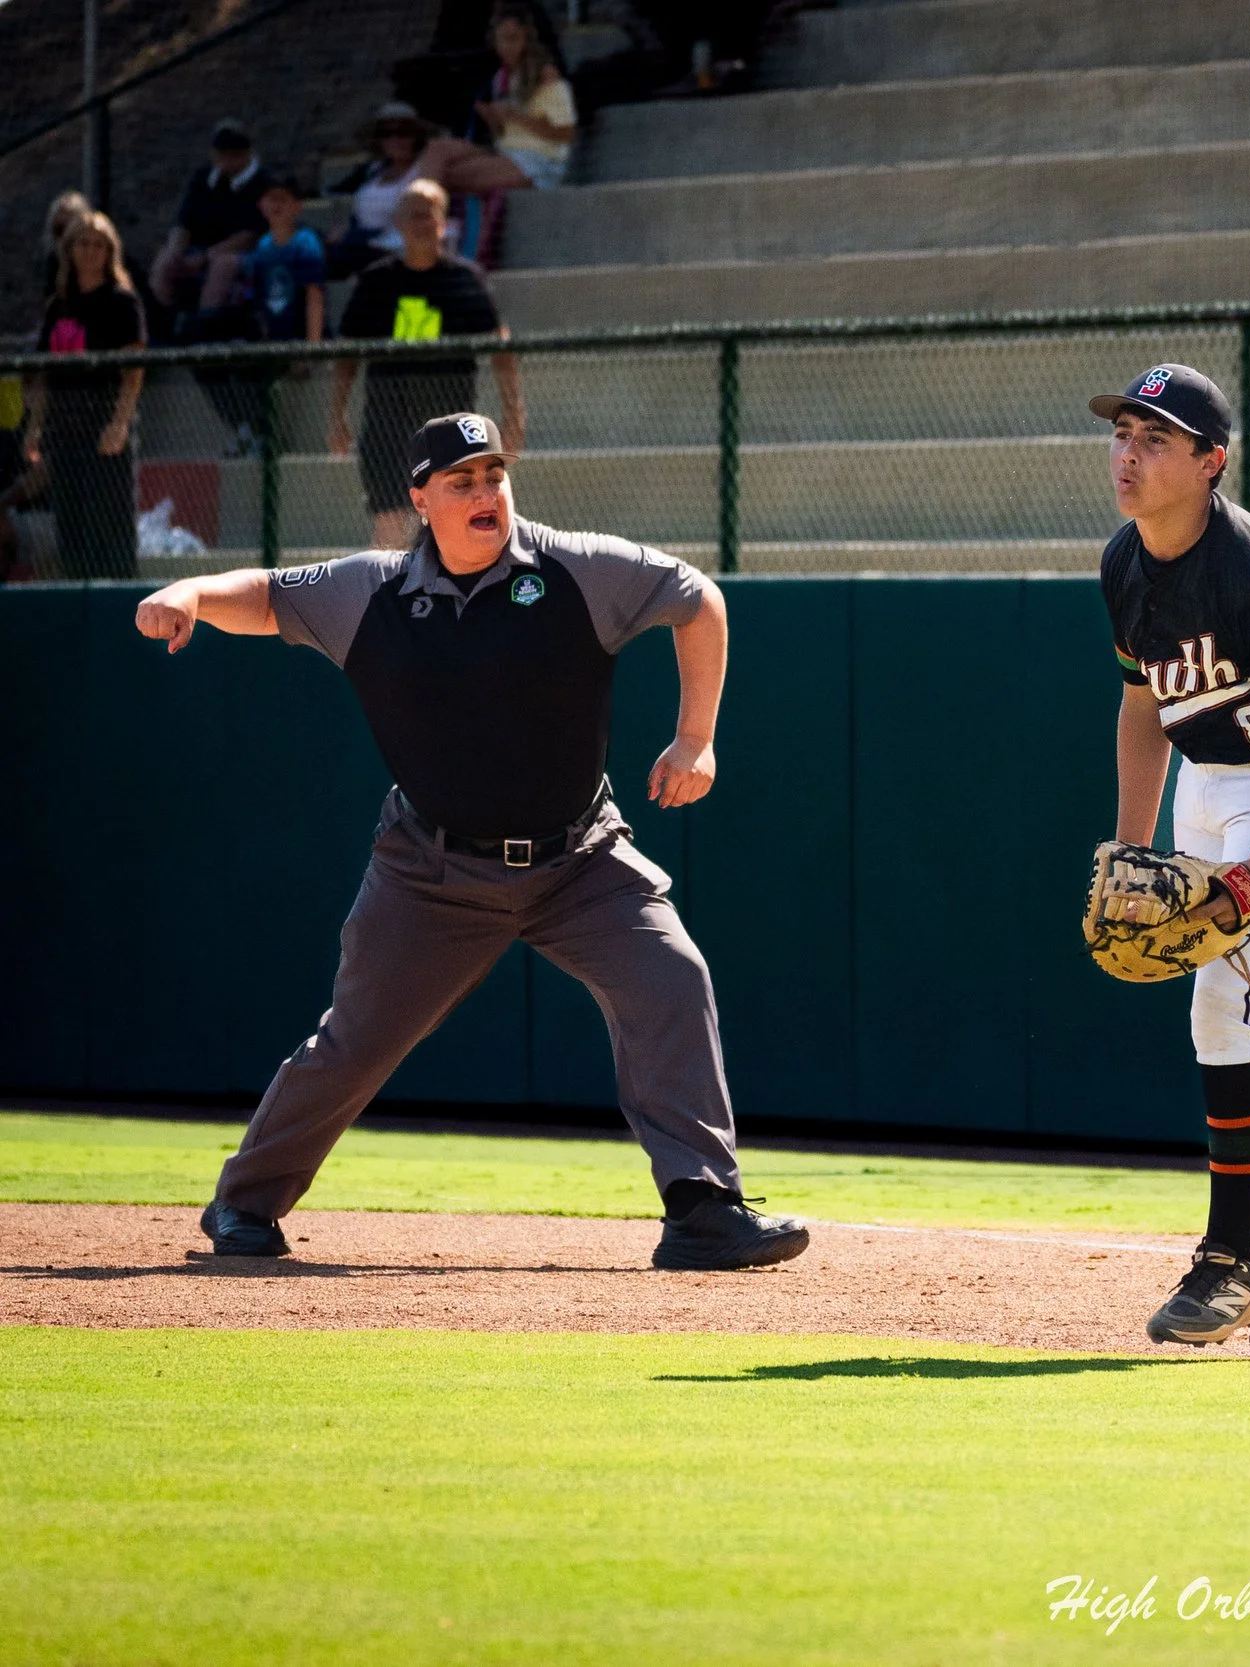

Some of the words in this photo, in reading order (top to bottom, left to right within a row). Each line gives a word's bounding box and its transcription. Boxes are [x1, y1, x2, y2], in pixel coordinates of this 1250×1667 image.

[1138, 368, 1173, 397] S
[1141, 633, 1240, 702] uth
[1160, 928, 1208, 957] Rawlings
